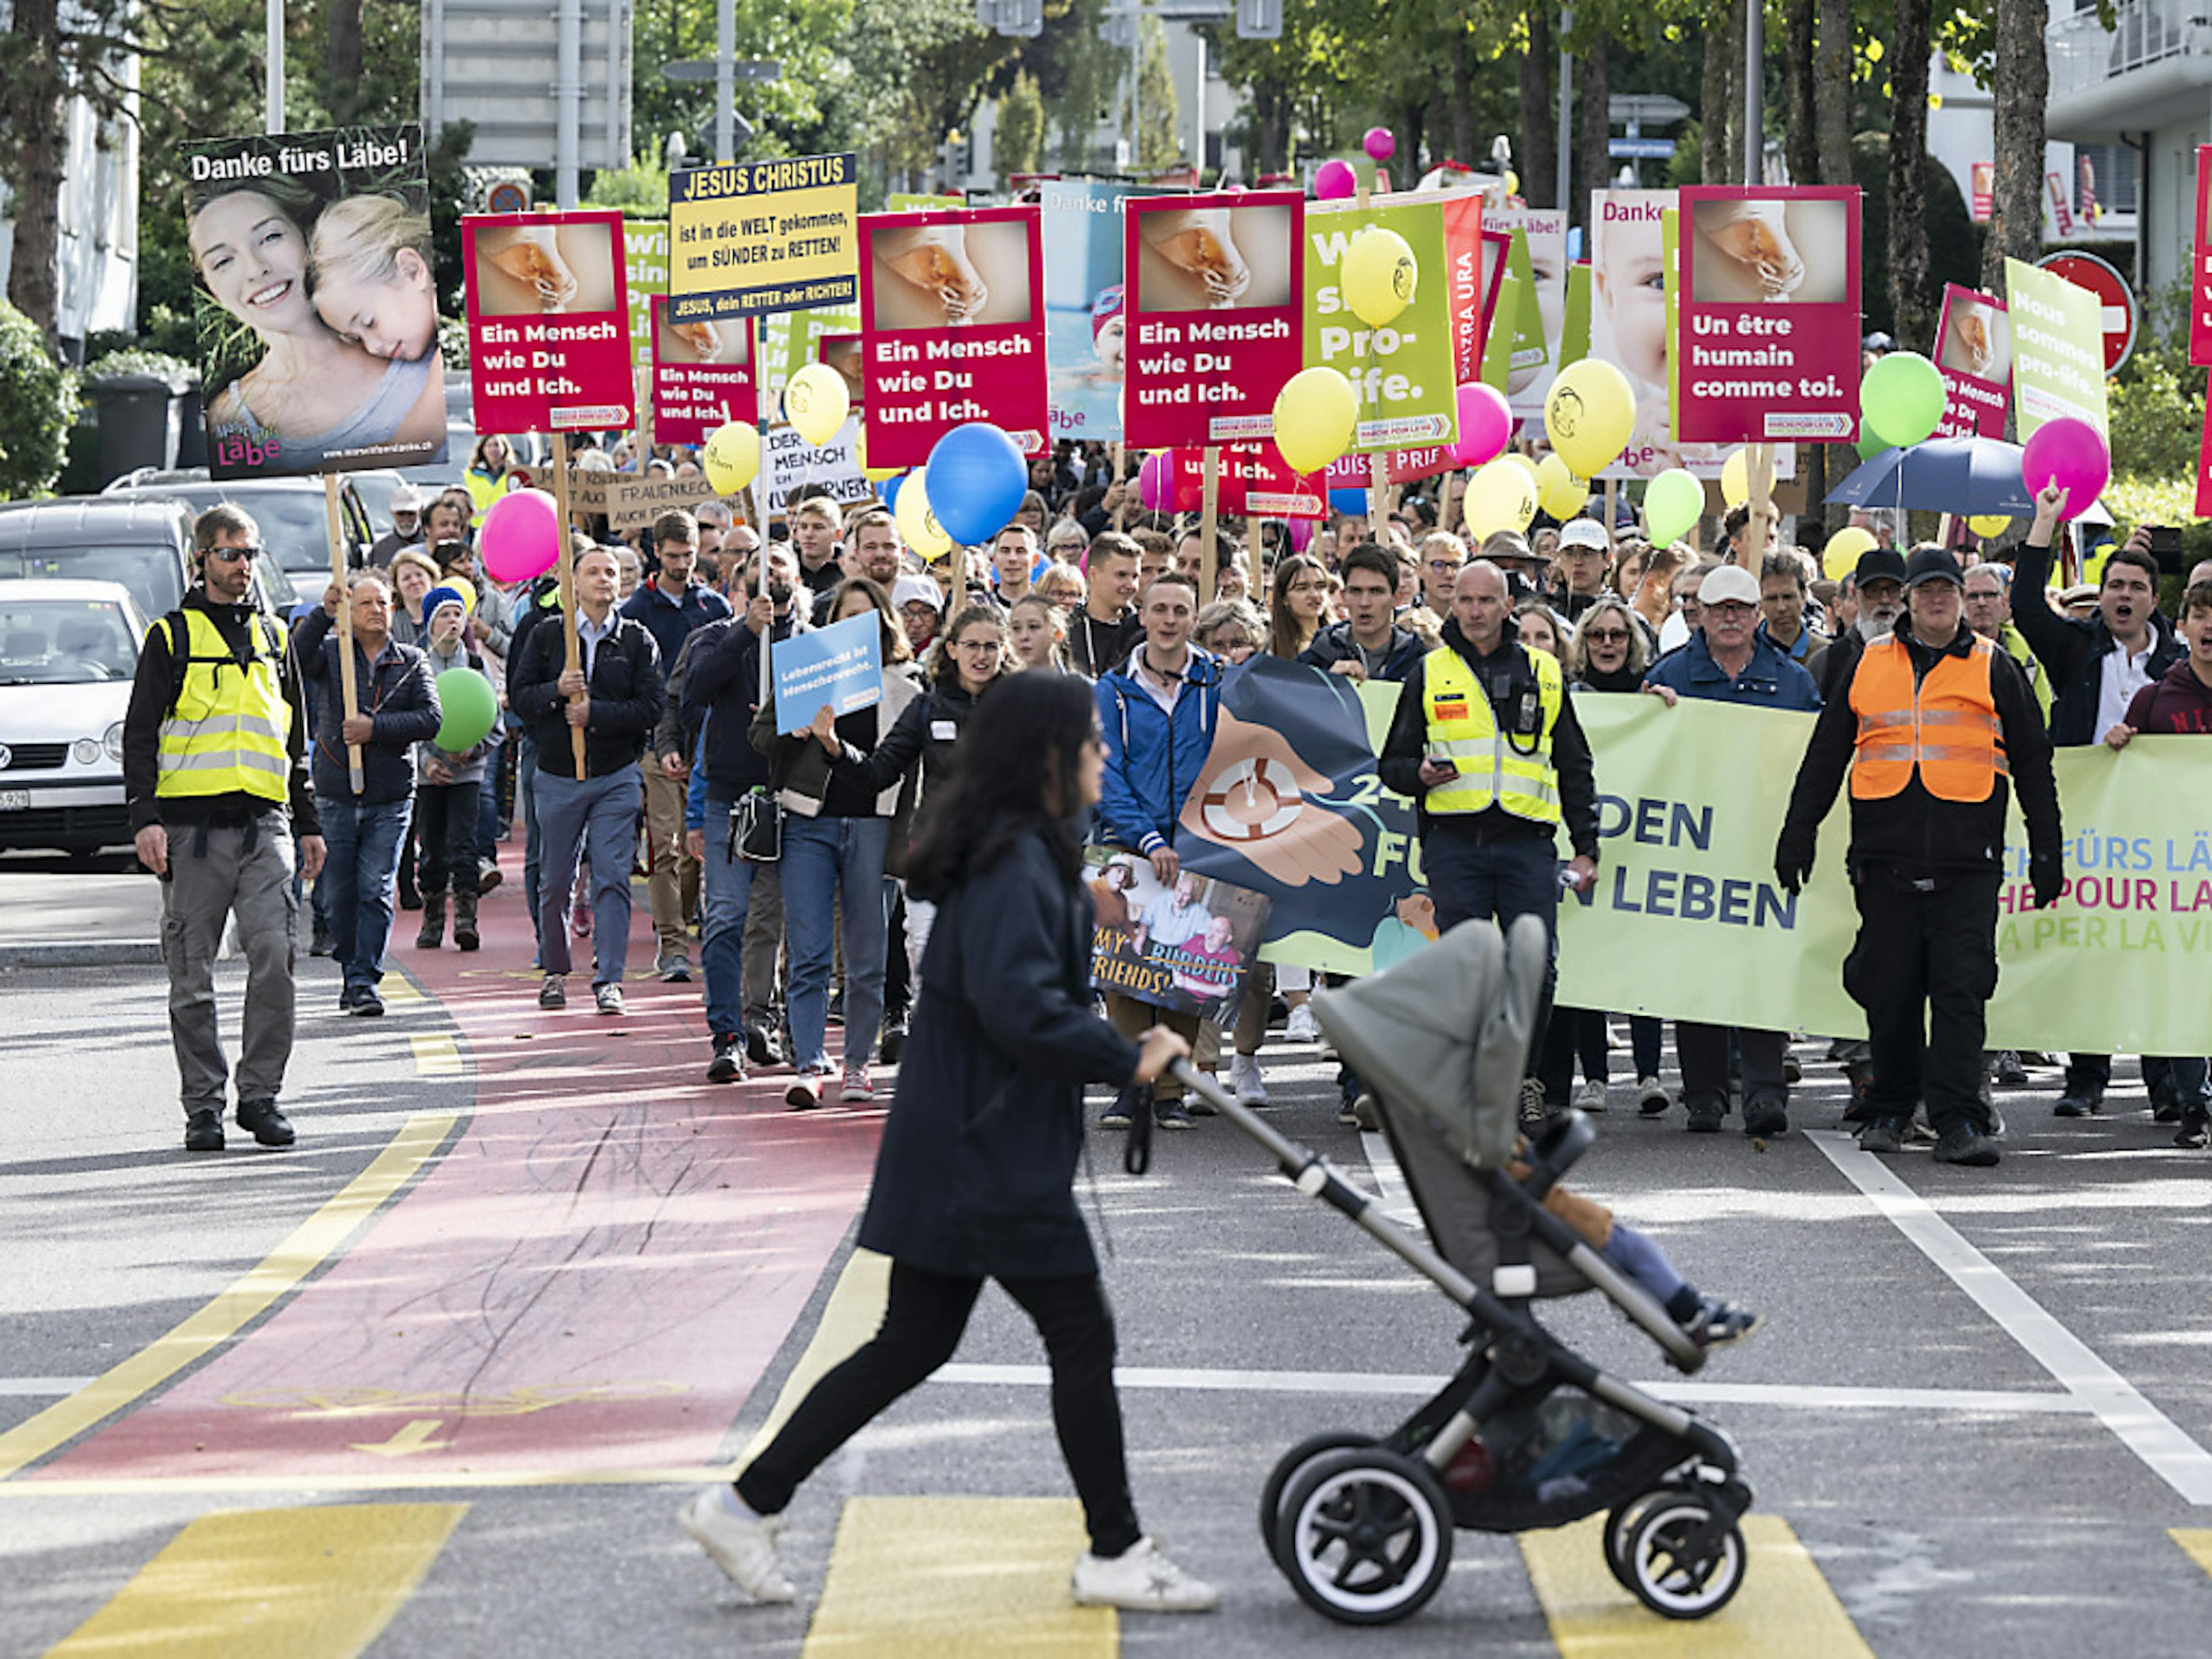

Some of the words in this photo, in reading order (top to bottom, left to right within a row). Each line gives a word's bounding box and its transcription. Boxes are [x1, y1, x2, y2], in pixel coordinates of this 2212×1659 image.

[191, 151, 272, 180] Danke
[278, 146, 330, 173] fürs
[337, 139, 408, 169] Läbe!
[684, 167, 748, 198] JESUS
[754, 157, 843, 192] CHRISTUS
[1050, 194, 1107, 213] Danke
[680, 225, 696, 243] ist
[700, 223, 712, 240] in
[717, 221, 737, 237] die
[741, 217, 776, 235] WELT
[779, 211, 847, 236] gekommen,
[688, 256, 707, 270] um
[713, 245, 768, 267] SÜNDER
[771, 248, 784, 260] zu
[789, 236, 841, 259] RETTEN!
[627, 259, 668, 282] sin
[1456, 252, 1474, 300] URA
[675, 298, 714, 316] JESUS,
[716, 296, 740, 312] dein
[742, 291, 781, 308] RETTER
[783, 289, 805, 303] oder
[806, 281, 852, 300] RICHTER!
[2014, 290, 2067, 326] Nous
[480, 323, 519, 343] Ein
[525, 321, 617, 342] Mensch
[1139, 321, 1180, 344] Ein
[1188, 317, 1290, 343] Mensch
[1692, 315, 1729, 335] Un
[1736, 313, 1793, 335] être
[876, 339, 919, 362] Ein
[926, 334, 1031, 359] Mensch
[1320, 327, 1416, 361] Pro-
[1692, 344, 1794, 366] humain
[2016, 323, 2098, 370] sommes
[483, 350, 525, 370] wie
[532, 351, 566, 369] Du
[1138, 351, 1187, 374] wie
[1194, 353, 1232, 373] Du
[485, 377, 531, 397] und
[537, 377, 582, 395] Ich.
[660, 369, 684, 382] Ein
[688, 370, 749, 384] Mensch
[877, 370, 927, 392] wie
[934, 370, 974, 390] Du
[1349, 366, 1423, 404] ife.
[1692, 381, 1793, 397] comme
[1798, 374, 1844, 397] toi.
[660, 386, 688, 400] wie
[692, 388, 714, 401] Du
[1139, 384, 1191, 404] und
[1198, 381, 1247, 403] Ich.
[1942, 375, 1956, 392] in
[1959, 380, 2005, 409] Mensch
[661, 405, 691, 418] und
[695, 405, 724, 419] Ich.
[878, 401, 931, 423] und
[939, 399, 990, 420] Ich.
[1050, 404, 1085, 429] äbe
[1959, 403, 1976, 421] Du
[1937, 422, 1955, 436] nd
[218, 435, 281, 466] Läbe
[767, 433, 801, 452] DER
[775, 446, 846, 470] MENSCH
[1185, 460, 1228, 476] ud
[1234, 461, 1277, 480] Ich.
[2166, 831, 2212, 872] LÄ
[1613, 866, 1798, 930] LEBEN
[1092, 927, 1127, 955] MY
[2033, 915, 2107, 950] PER
[2120, 919, 2166, 951] LA
[1092, 956, 1171, 997] RIENDS!
